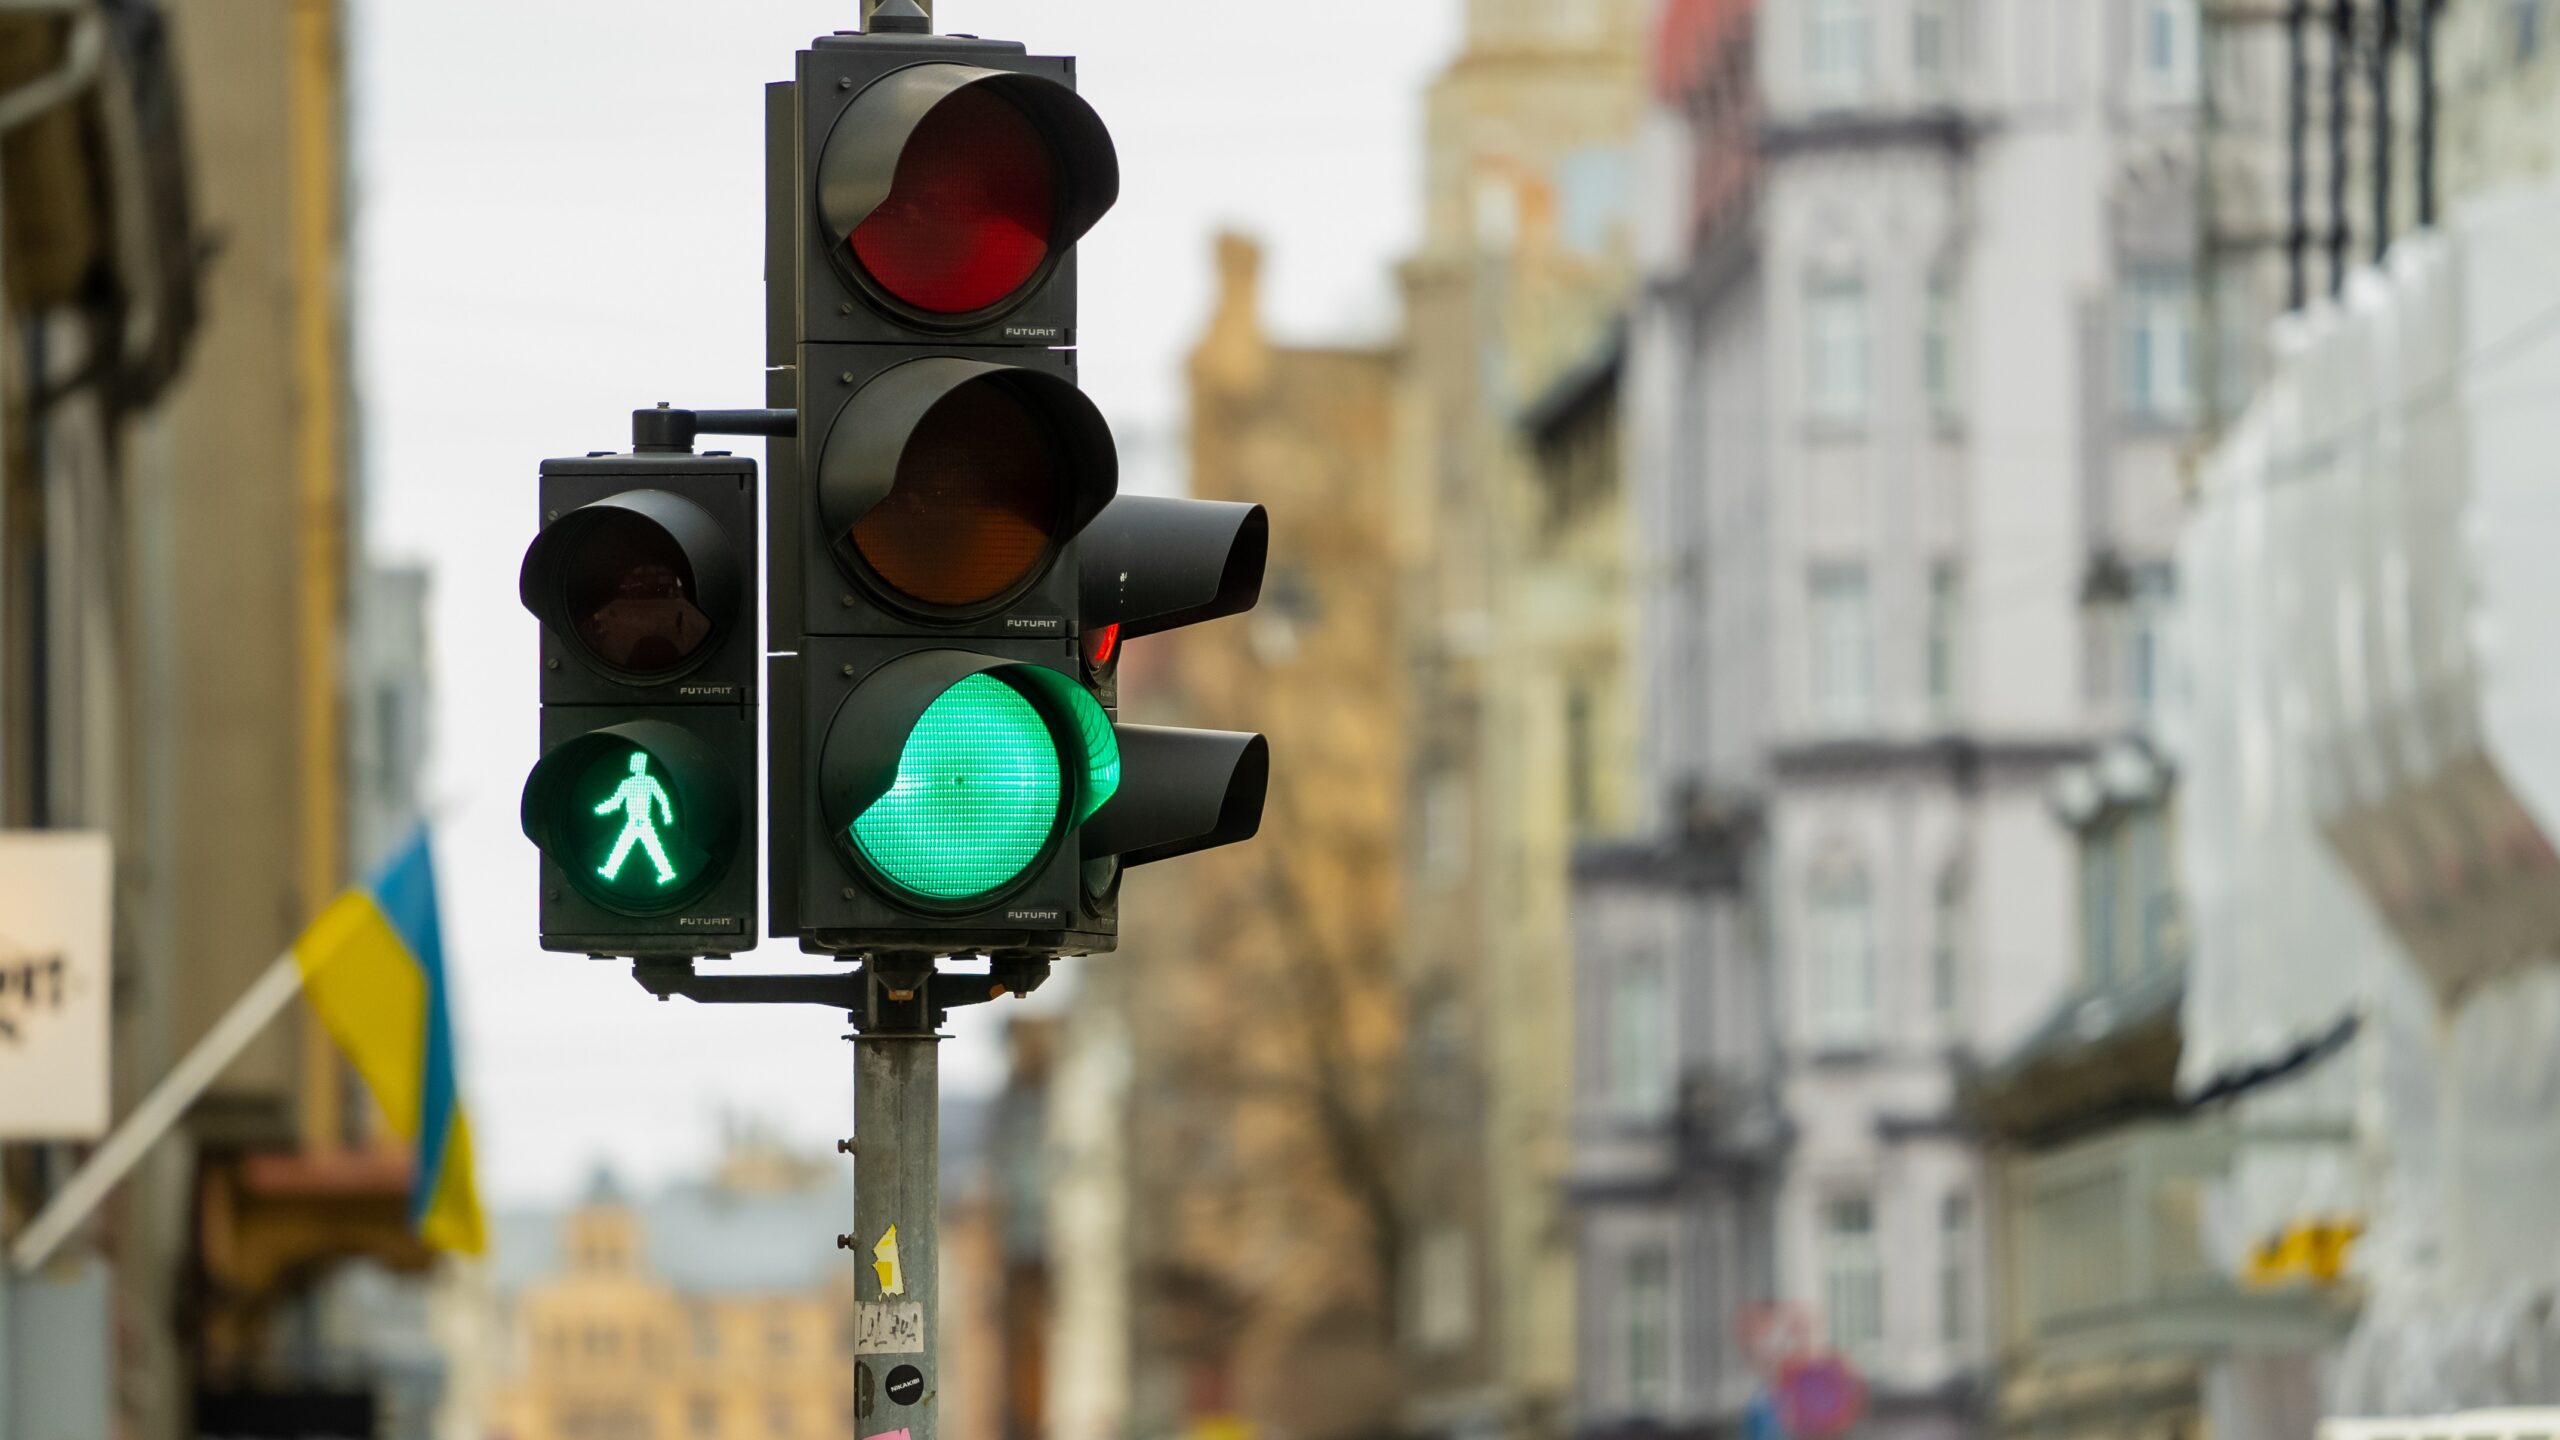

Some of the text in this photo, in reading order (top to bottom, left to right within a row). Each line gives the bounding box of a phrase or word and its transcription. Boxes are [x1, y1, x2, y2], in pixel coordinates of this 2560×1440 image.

[1005, 327, 1057, 337] FUTURIT
[1007, 619, 1058, 628] FUTURIT
[680, 686, 732, 695] FUTURIT
[1007, 911, 1058, 920] FUTURIT
[679, 917, 731, 926] FUTURIT
